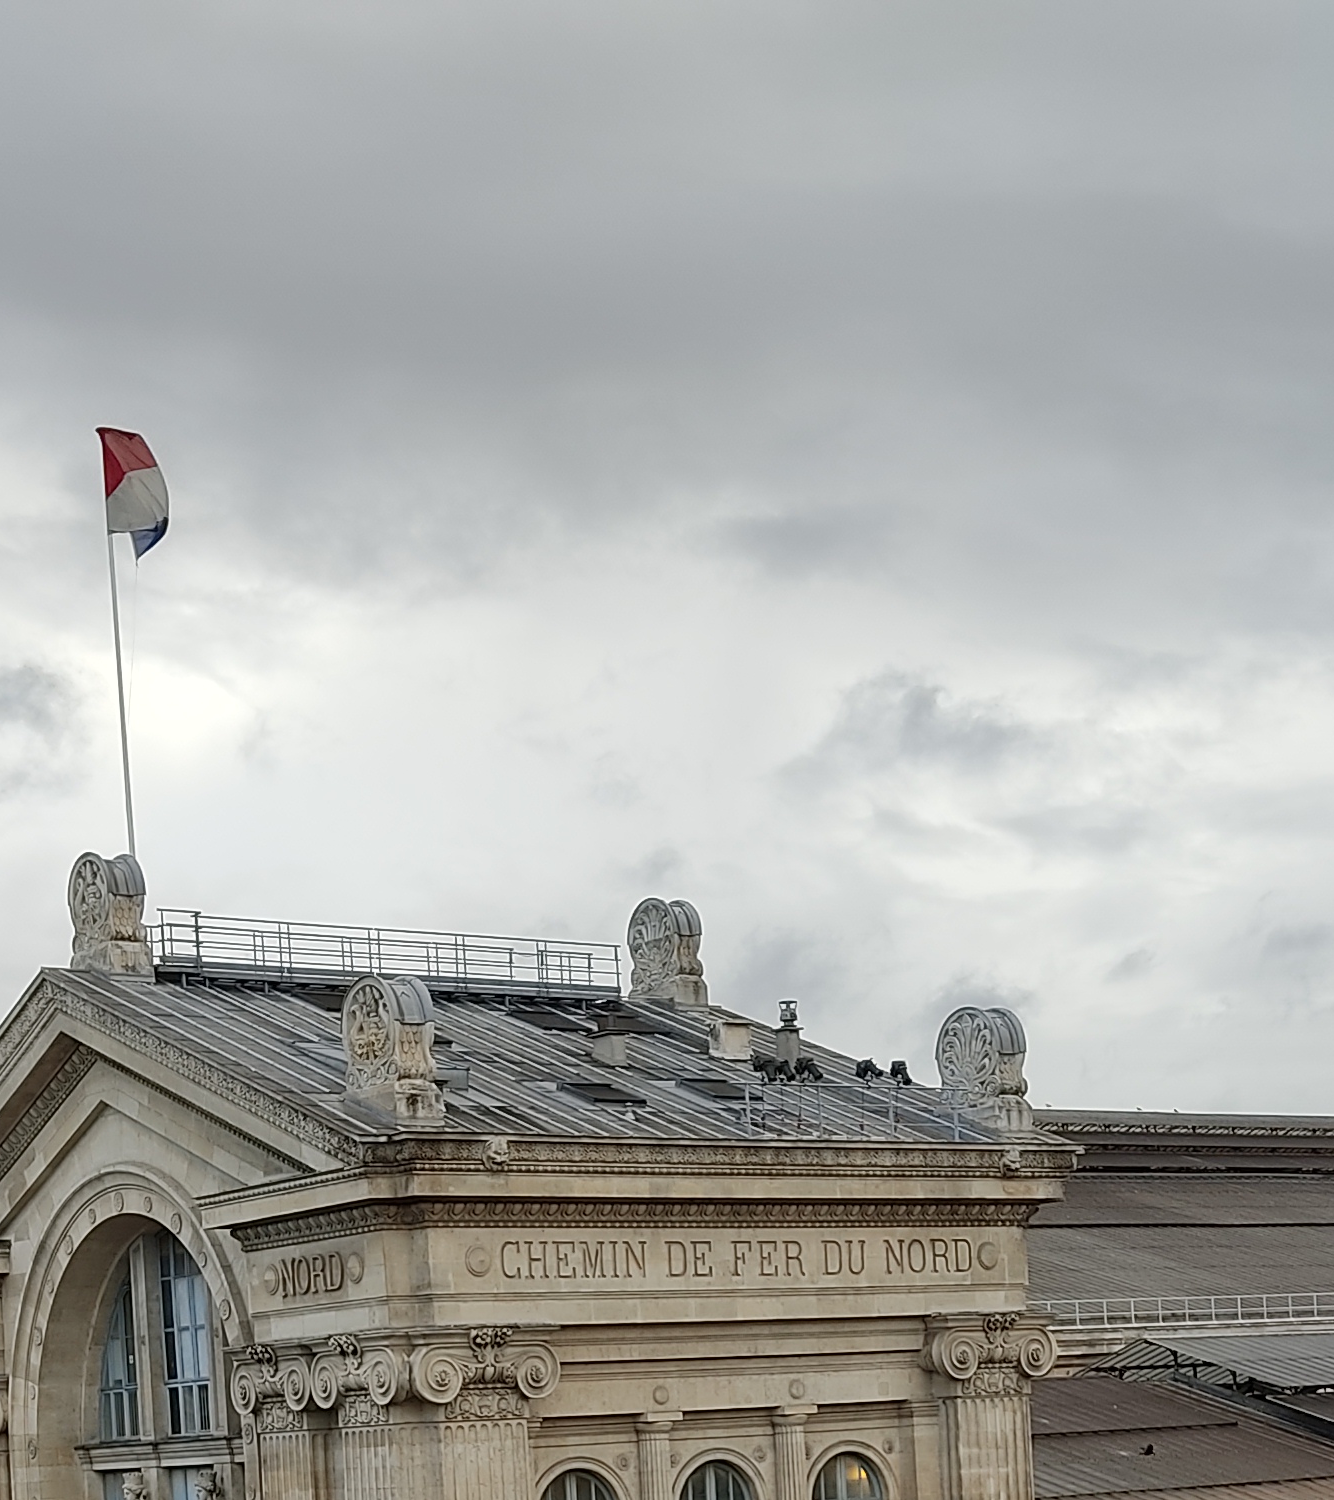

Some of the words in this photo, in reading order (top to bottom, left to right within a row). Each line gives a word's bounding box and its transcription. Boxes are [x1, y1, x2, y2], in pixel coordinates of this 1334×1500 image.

[279, 1251, 344, 1298] NORD
[501, 1240, 647, 1279] CHEMIN
[664, 1240, 714, 1278] DE
[730, 1240, 806, 1277] FER
[821, 1239, 866, 1276] DU
[883, 1238, 972, 1275] NORD
